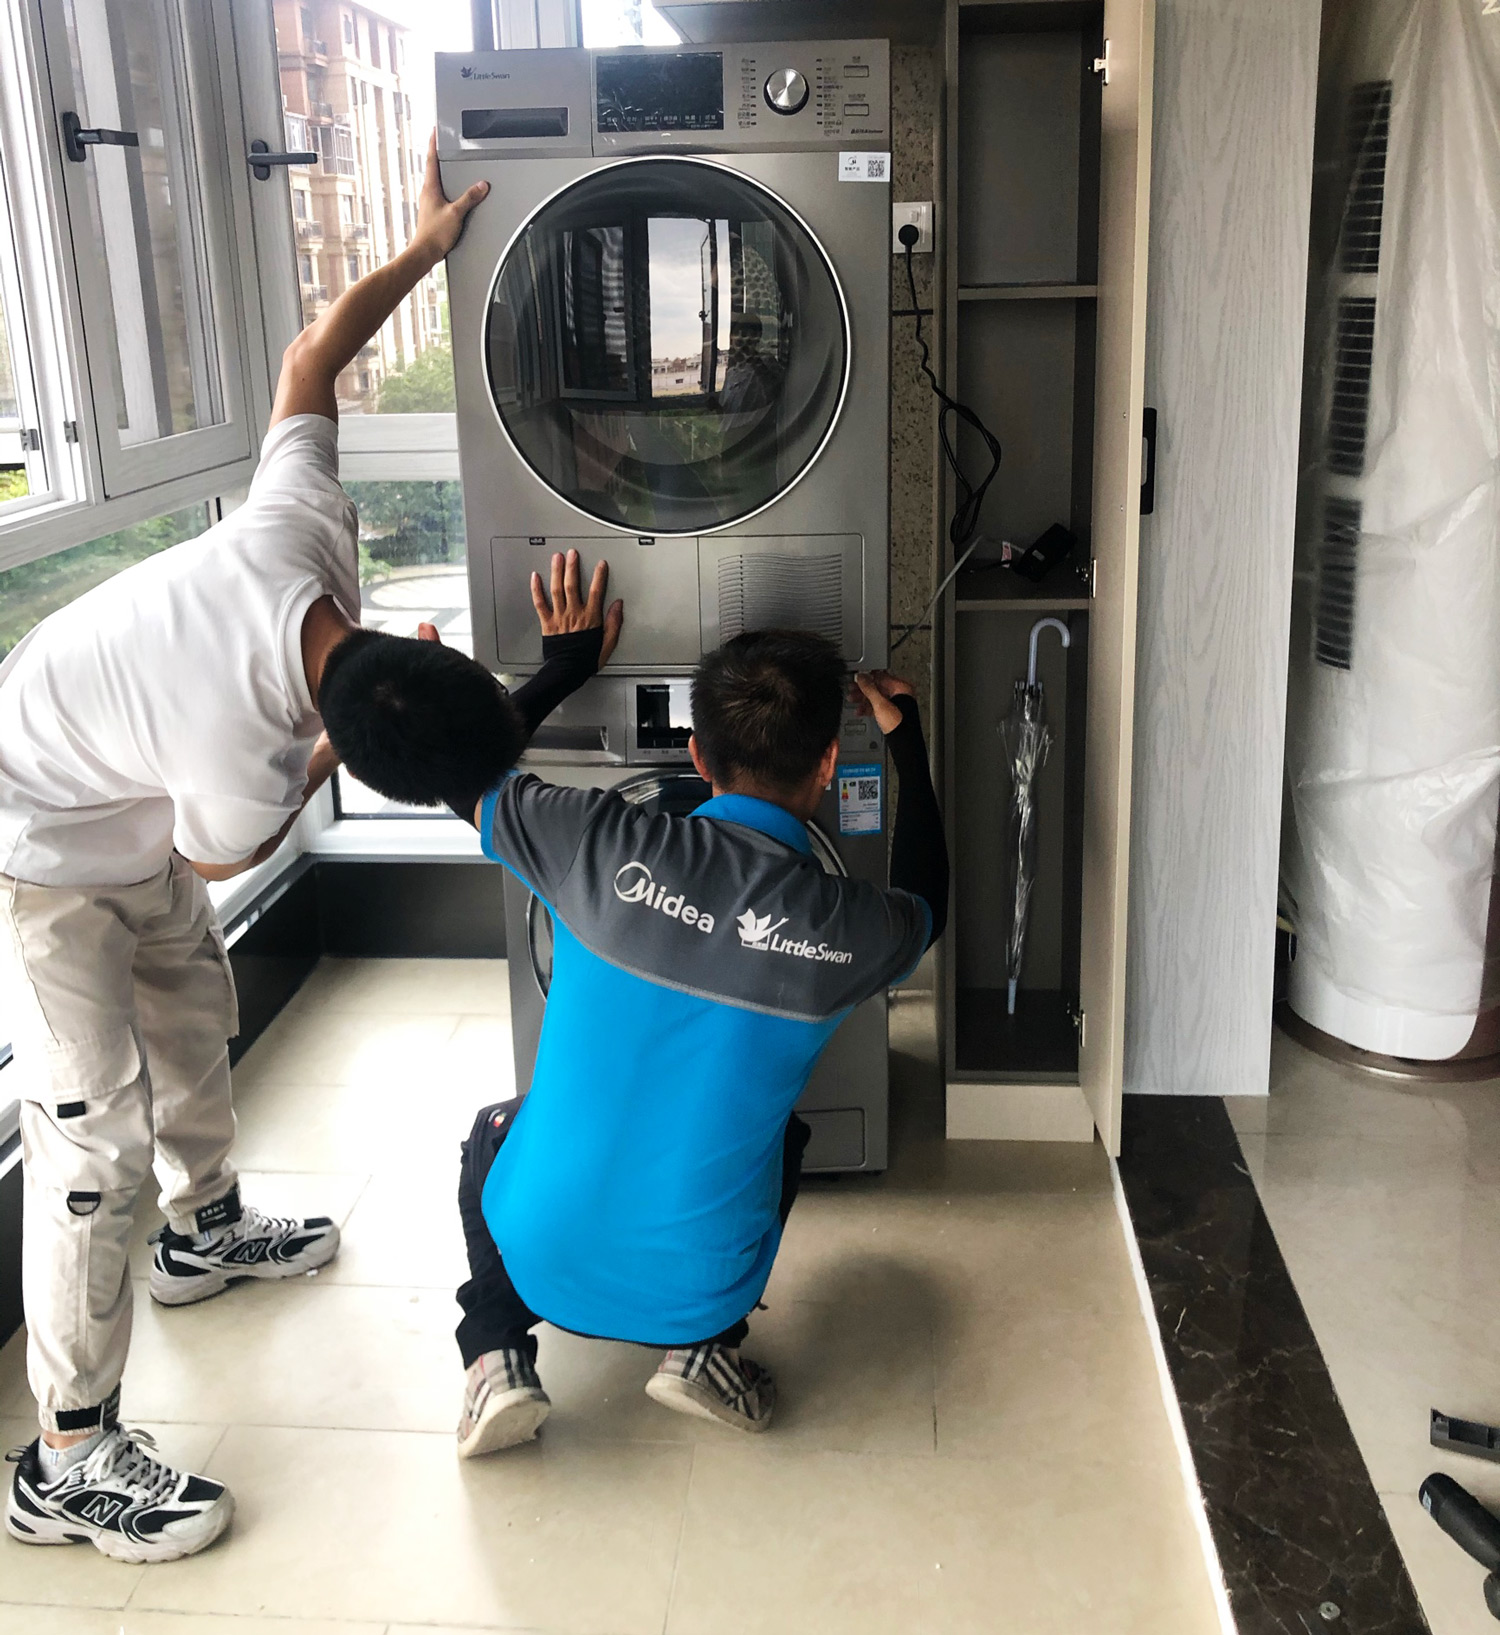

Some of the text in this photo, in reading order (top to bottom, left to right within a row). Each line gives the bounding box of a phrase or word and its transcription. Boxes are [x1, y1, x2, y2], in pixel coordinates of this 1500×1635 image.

[473, 72, 511, 80] LittleSwan
[614, 861, 715, 934] Midea
[770, 933, 853, 964] LittleSwan
[234, 1241, 267, 1262] N
[80, 1493, 123, 1526] N
